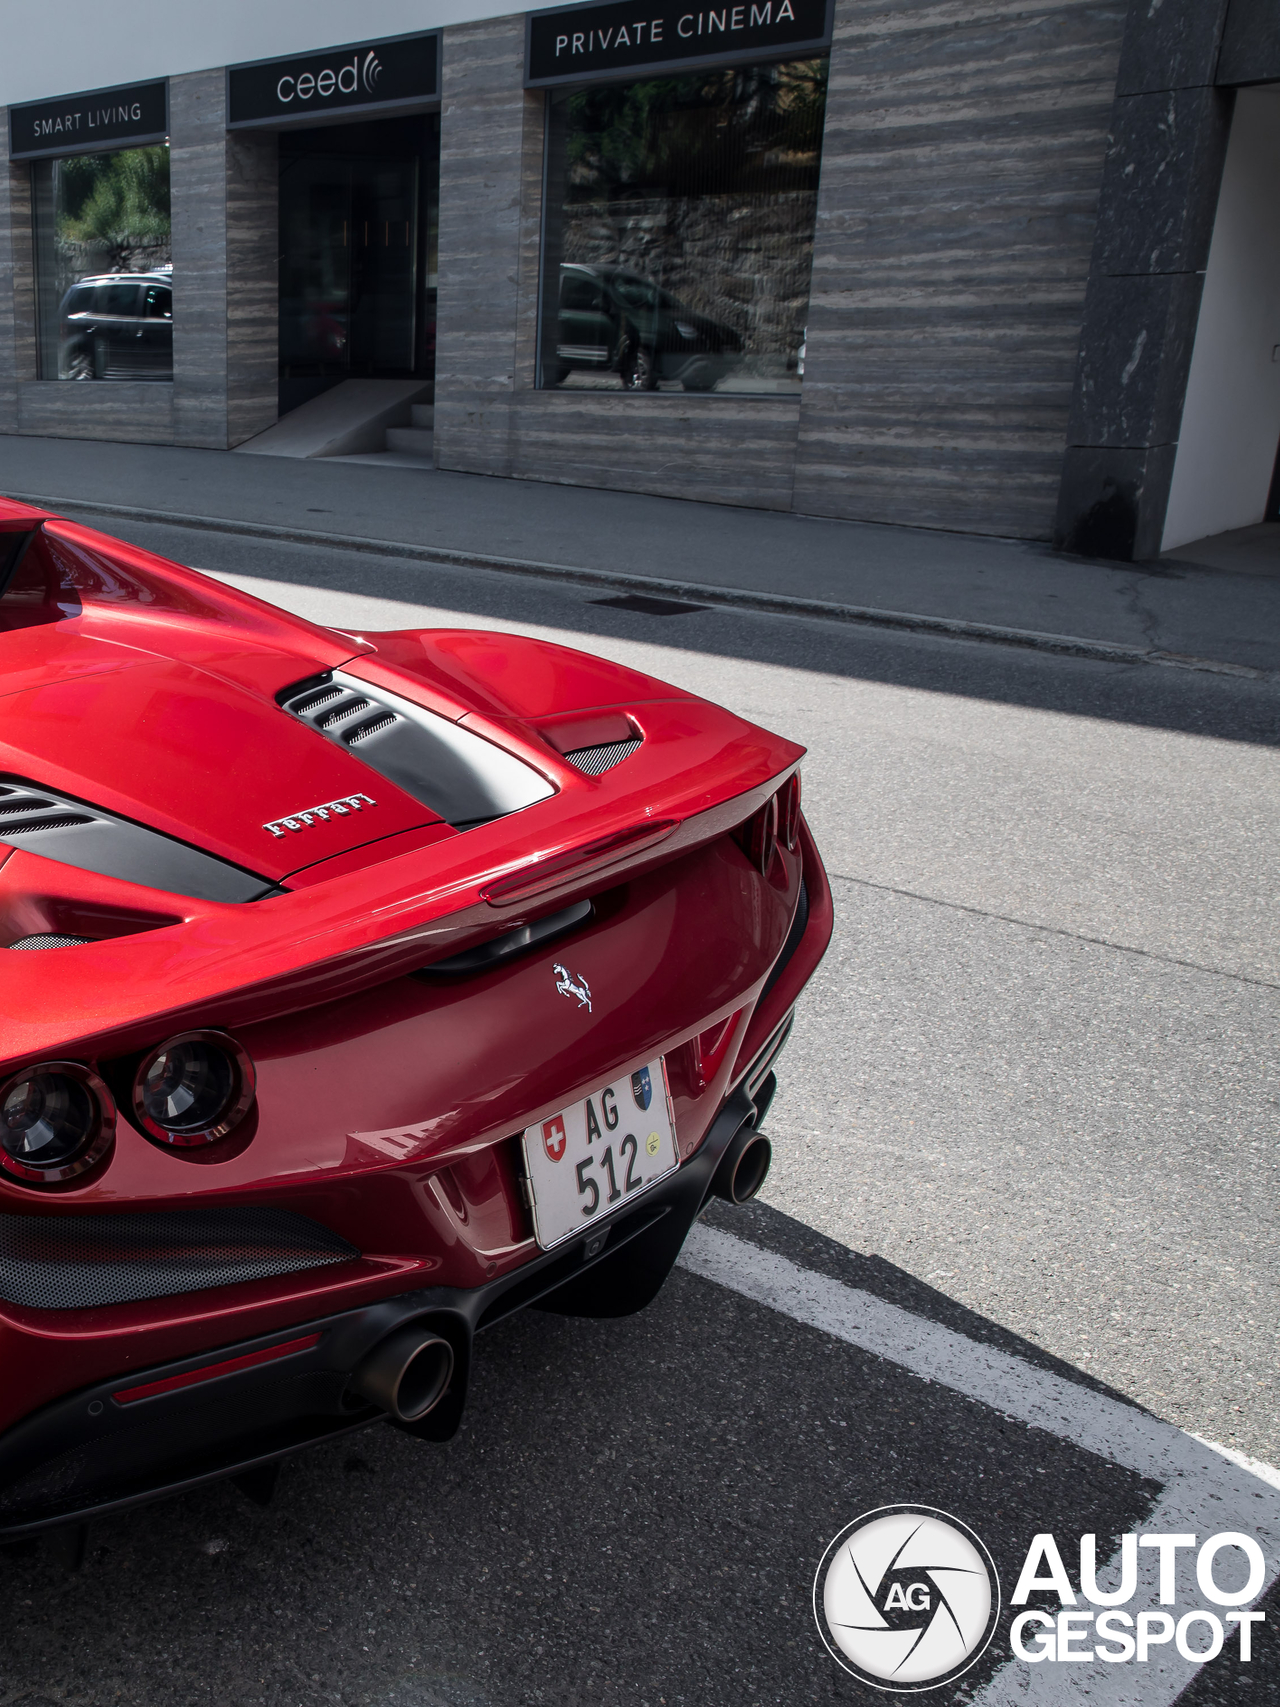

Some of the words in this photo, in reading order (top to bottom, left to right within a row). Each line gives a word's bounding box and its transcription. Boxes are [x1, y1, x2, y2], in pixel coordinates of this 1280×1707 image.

[555, 19, 664, 57] PRIVATE
[677, 0, 795, 38] CINEMA
[277, 56, 358, 103] ceed
[33, 112, 82, 137] SMART
[88, 103, 141, 128] LIVING
[262, 793, 377, 837] Ferrari
[584, 1087, 619, 1145] AG
[575, 1133, 642, 1217] 512
